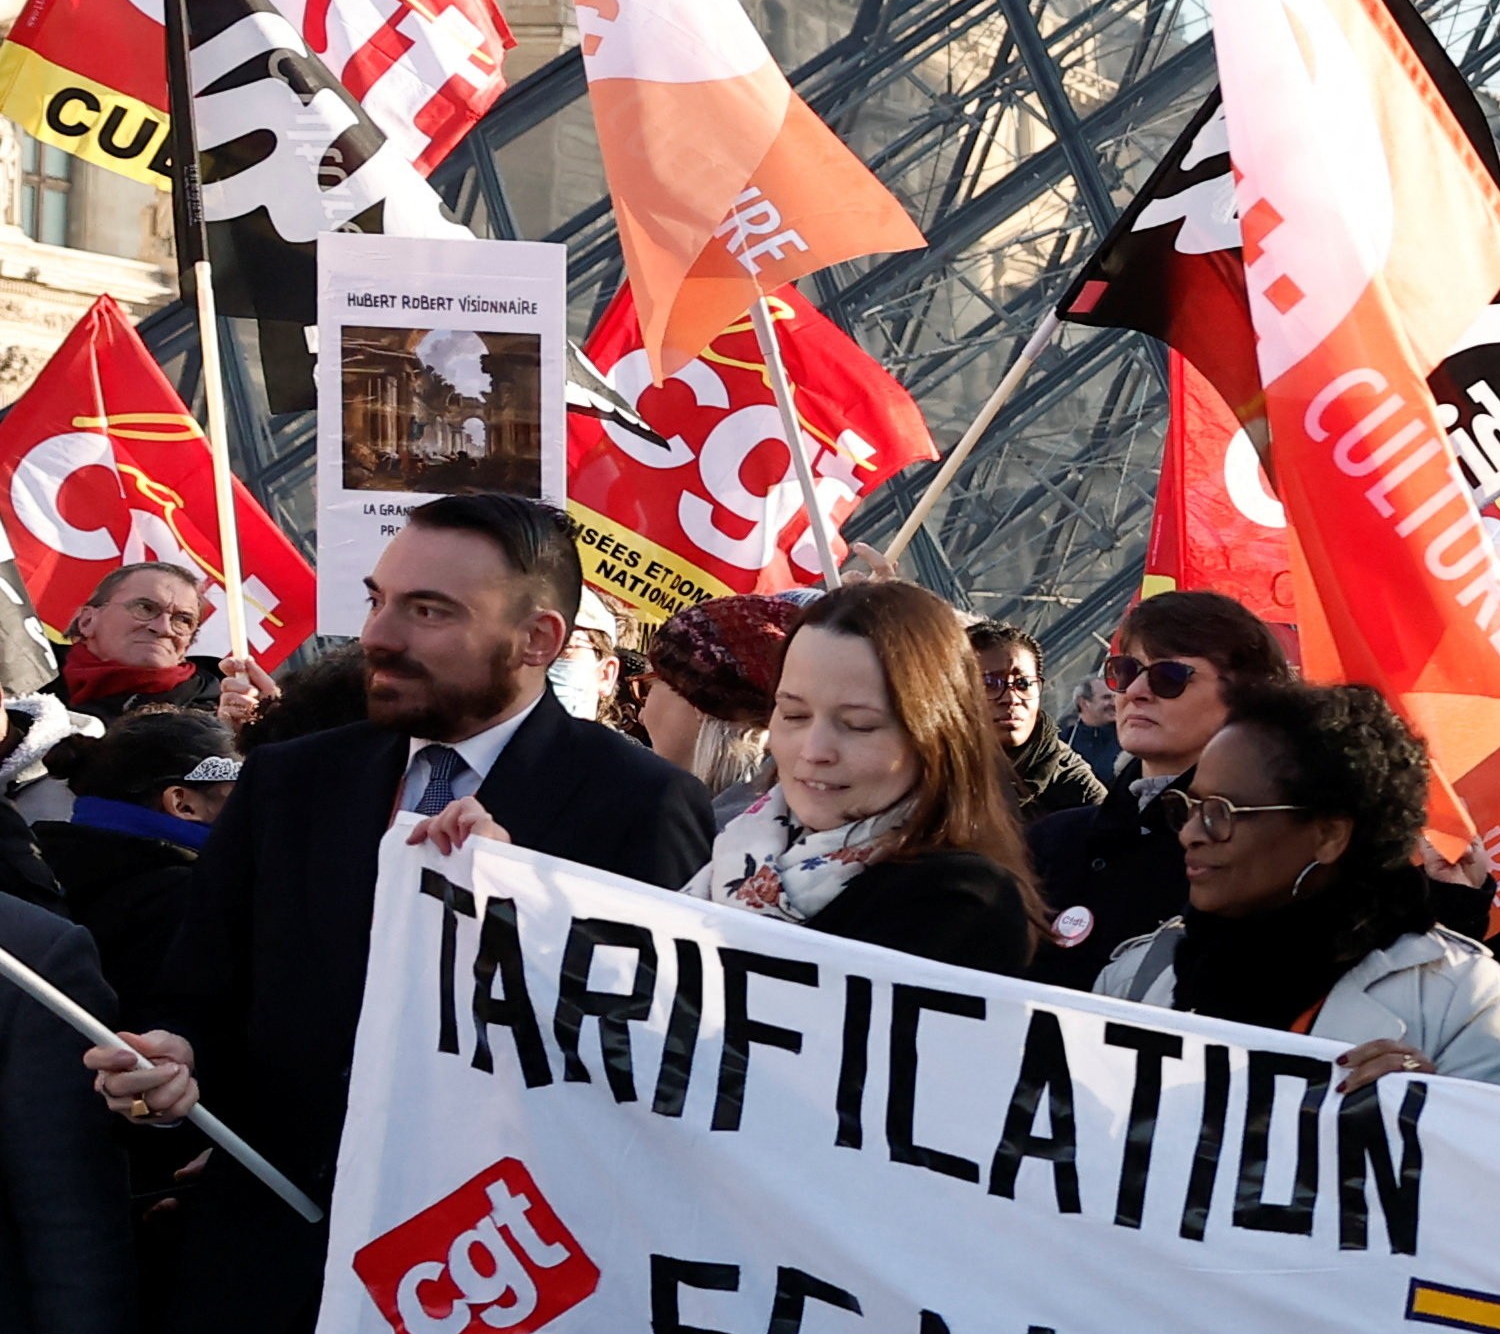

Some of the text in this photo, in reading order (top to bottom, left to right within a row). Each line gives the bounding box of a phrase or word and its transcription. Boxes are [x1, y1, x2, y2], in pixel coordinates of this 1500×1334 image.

[363, 503, 376, 515] LA
[601, 348, 876, 573] cgt
[645, 561, 673, 583] ET
[419, 869, 1428, 1257] TARIFICATION
